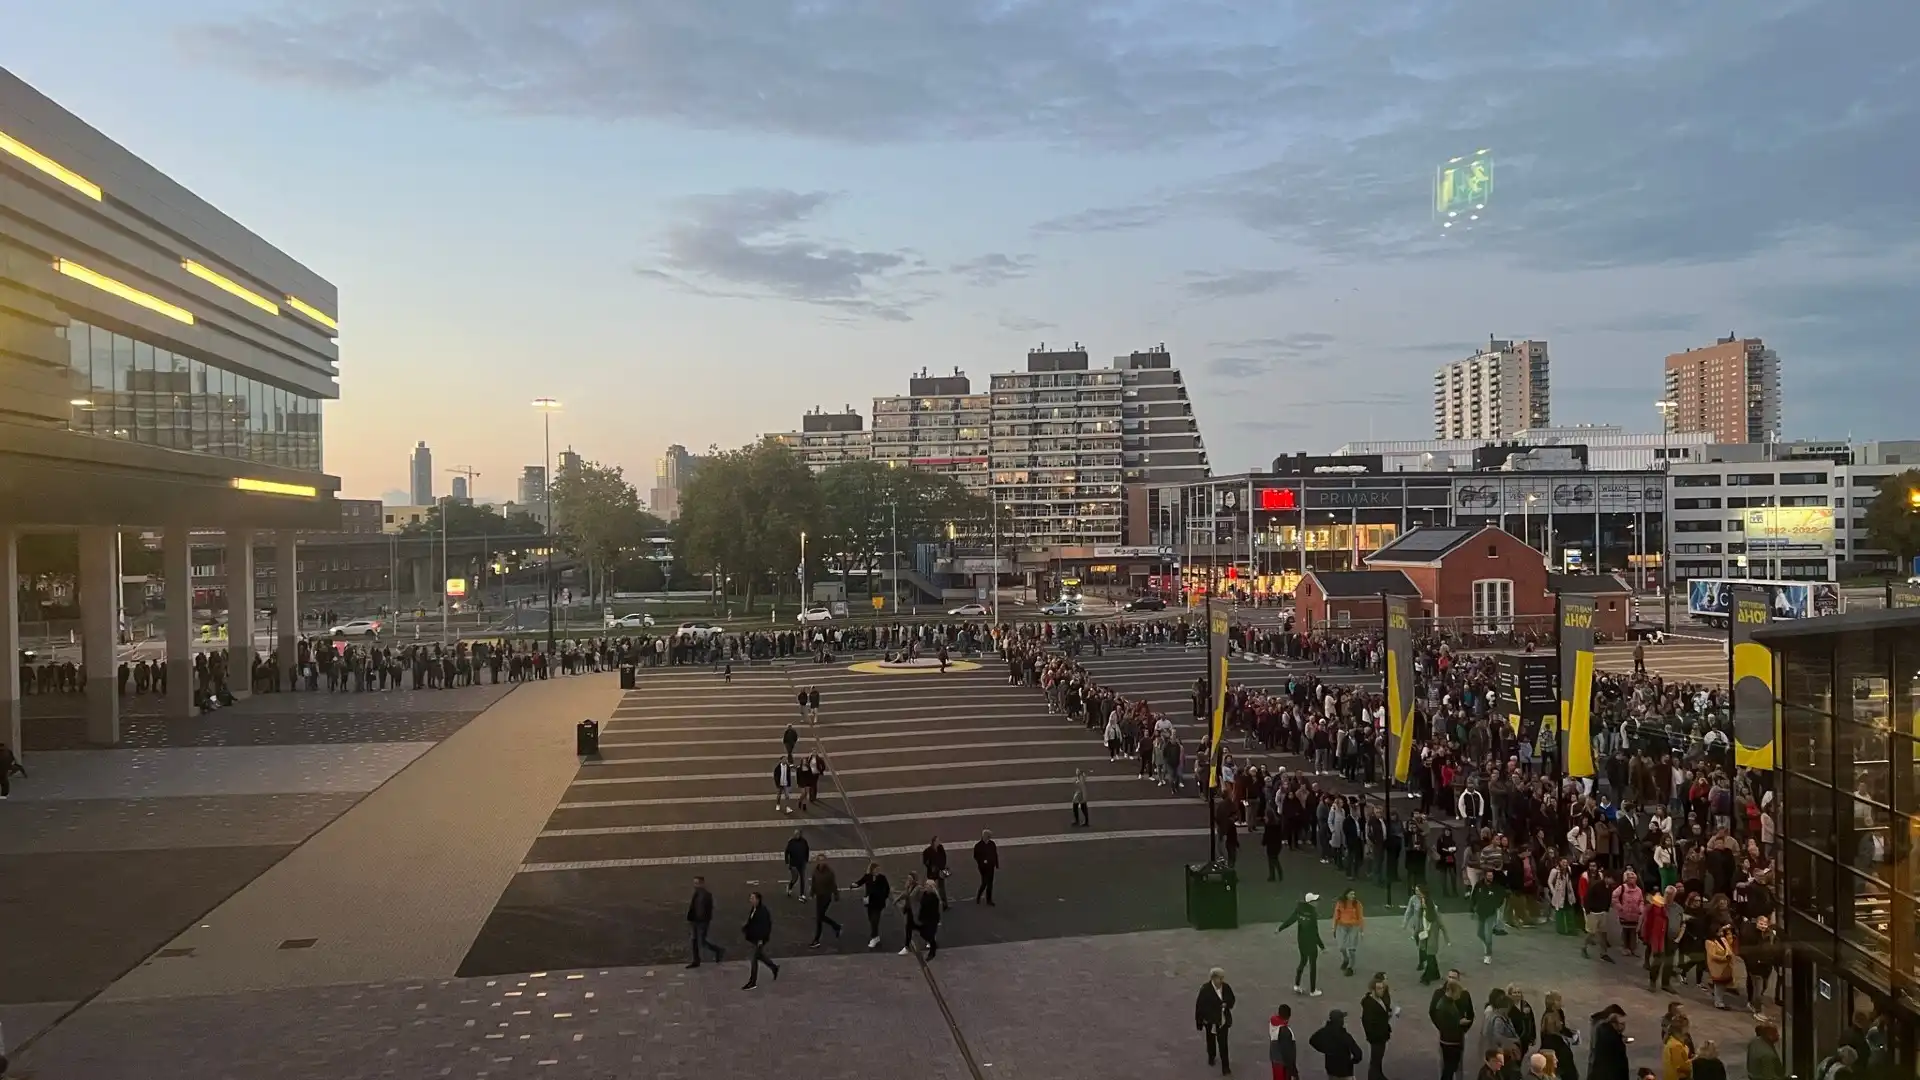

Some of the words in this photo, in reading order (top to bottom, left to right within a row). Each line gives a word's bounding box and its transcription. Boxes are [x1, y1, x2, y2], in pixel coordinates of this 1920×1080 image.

[1320, 492, 1391, 505] PRIMARK
[1564, 613, 1593, 628] AHOY
[1737, 609, 1767, 624] AHOY
